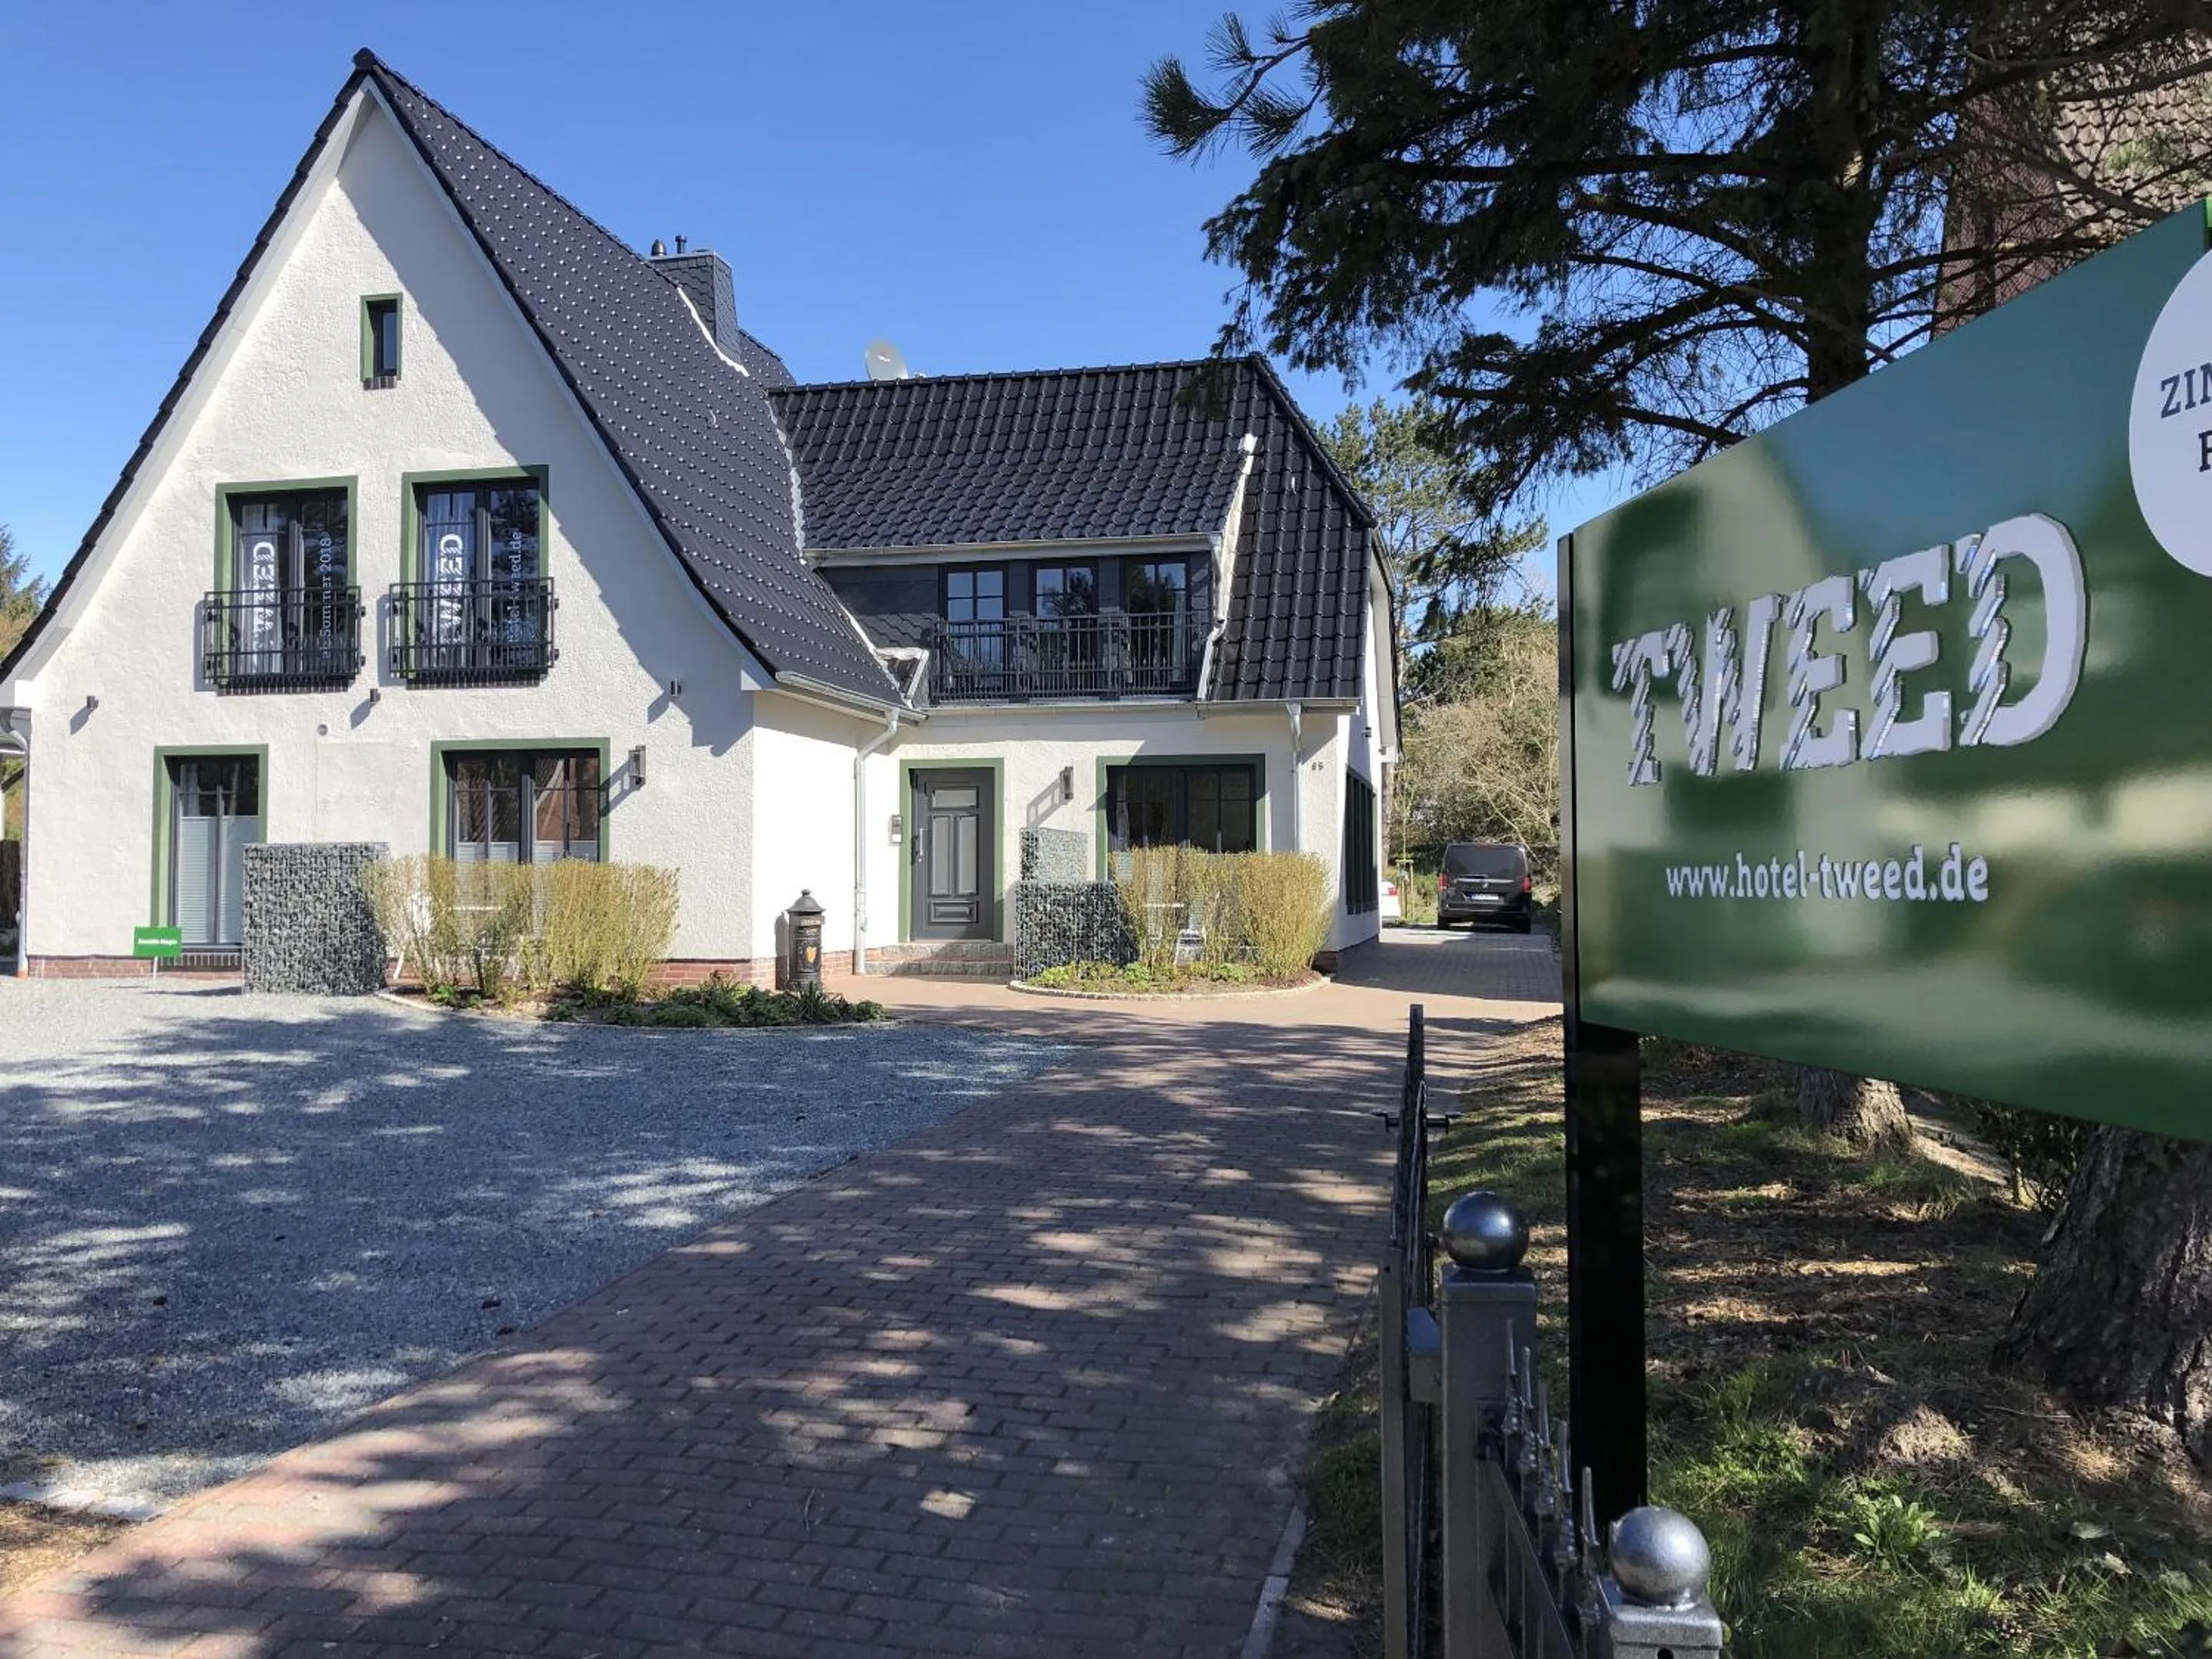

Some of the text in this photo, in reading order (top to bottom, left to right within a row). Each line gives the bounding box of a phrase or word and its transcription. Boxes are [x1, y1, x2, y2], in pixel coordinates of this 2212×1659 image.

[320, 537, 332, 572] 2018
[320, 576, 332, 638] Sommer
[1612, 513, 2088, 786] TWEED
[1665, 843, 1988, 902] www.hotel-tweed.de
